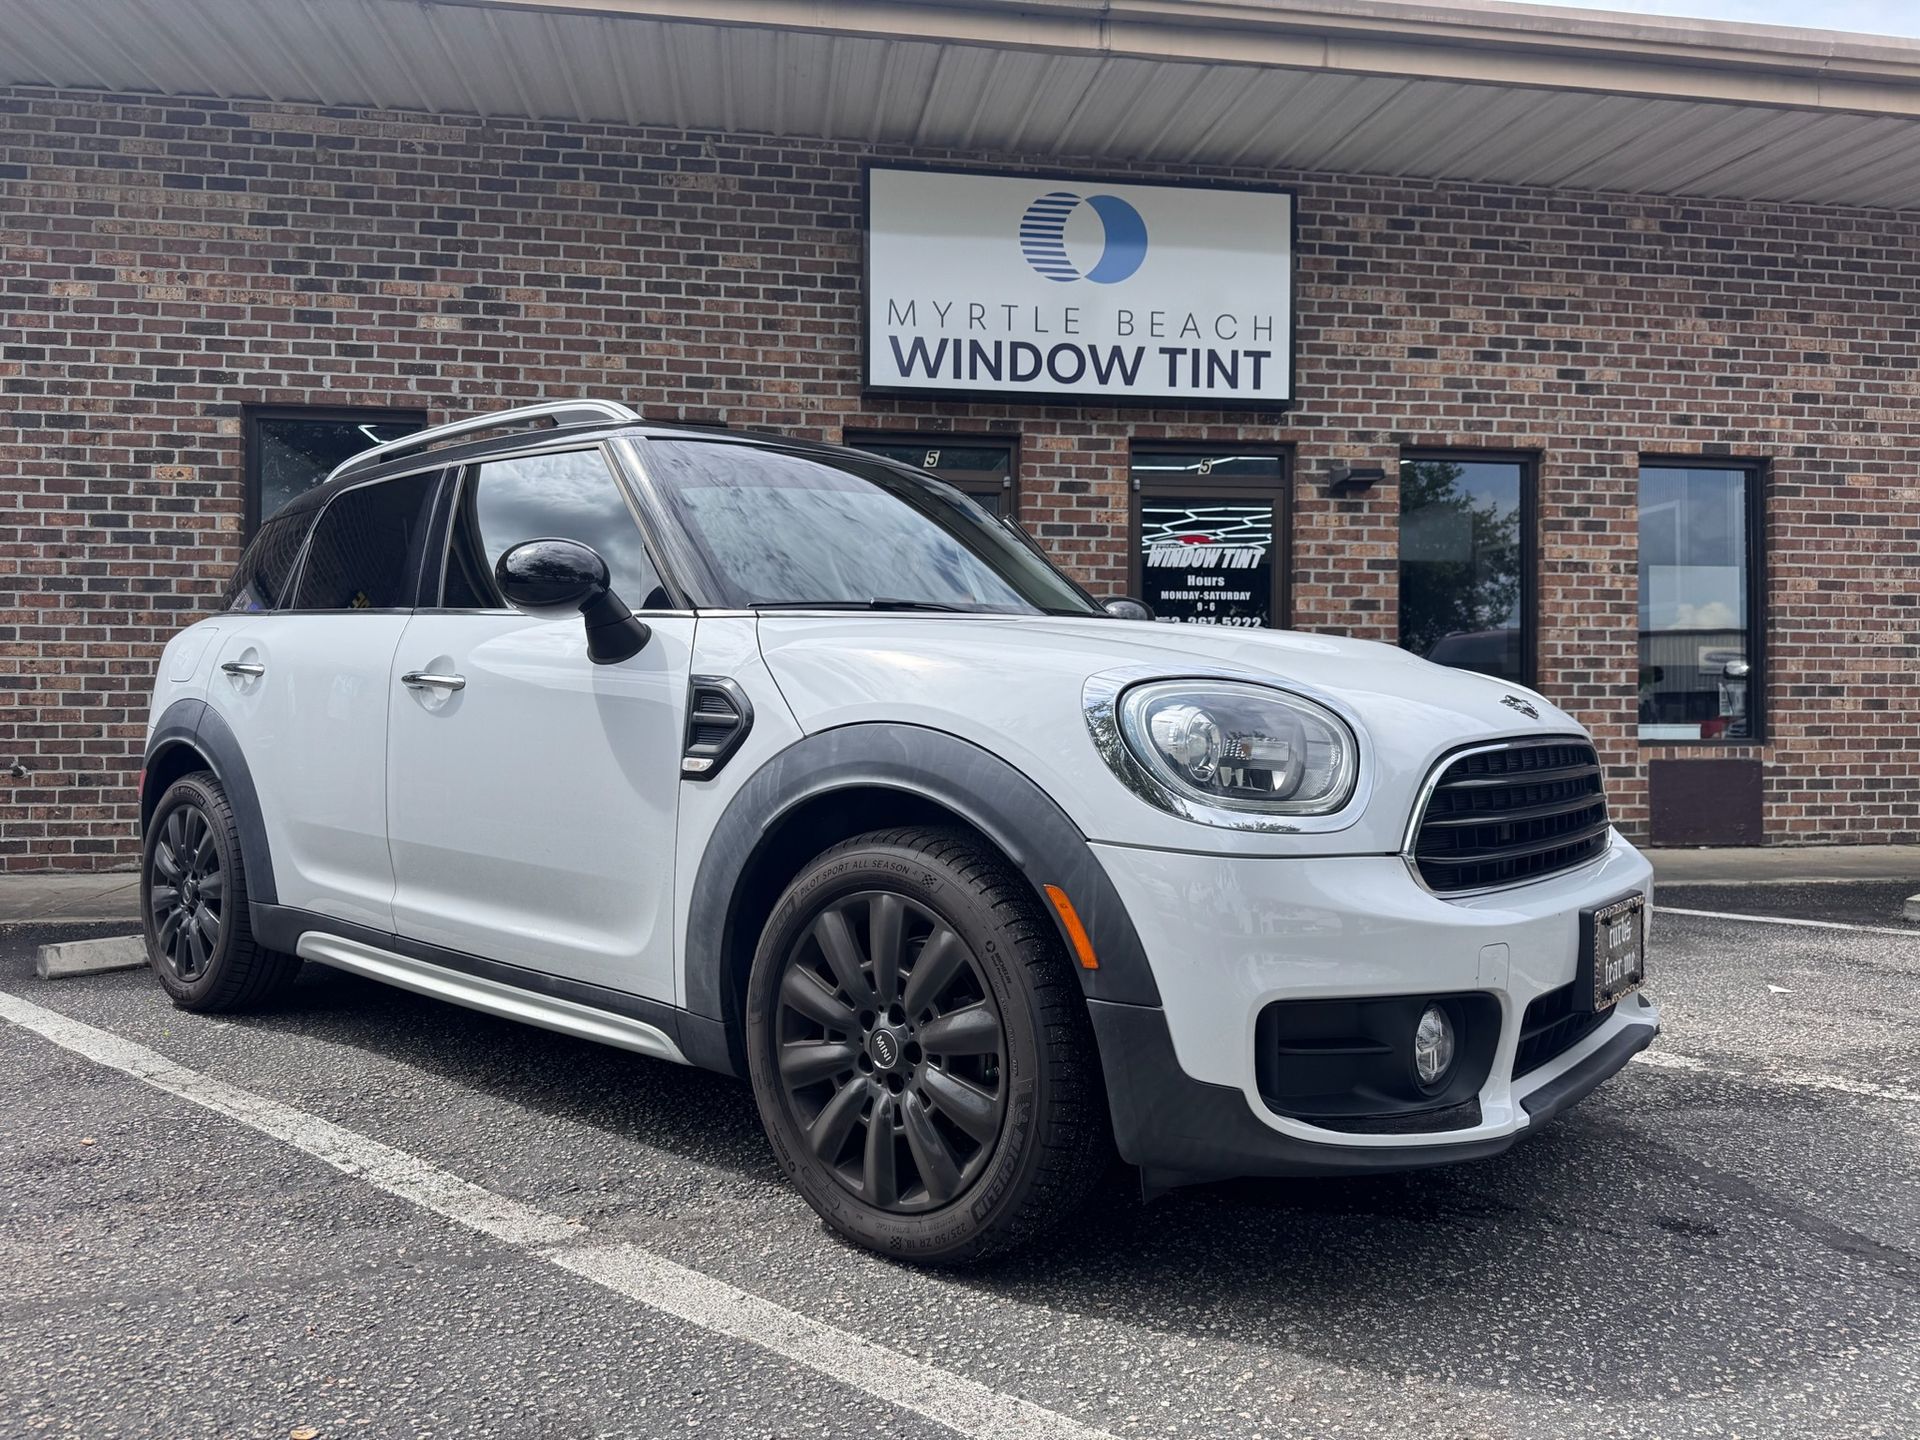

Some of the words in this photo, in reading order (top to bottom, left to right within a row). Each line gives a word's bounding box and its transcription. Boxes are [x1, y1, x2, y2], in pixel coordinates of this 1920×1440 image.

[887, 298, 1081, 335] MYRTLE
[1117, 309, 1273, 342] BEACH
[888, 335, 1146, 386] WINDOW
[1158, 346, 1272, 390] TINT
[926, 451, 939, 466] 5
[1199, 459, 1214, 474] 5
[1147, 545, 1224, 568] WINDOW
[1221, 548, 1266, 569] TINT
[1187, 575, 1225, 587] Hours
[1161, 591, 1252, 601] MONDAY-SATURDAY
[800, 875, 824, 896] PILOT
[823, 862, 849, 880] SPORT
[852, 860, 869, 870] ALL
[872, 859, 910, 875] SEASON
[876, 1035, 892, 1062] MINI
[976, 1127, 1025, 1219] MICHELIN
